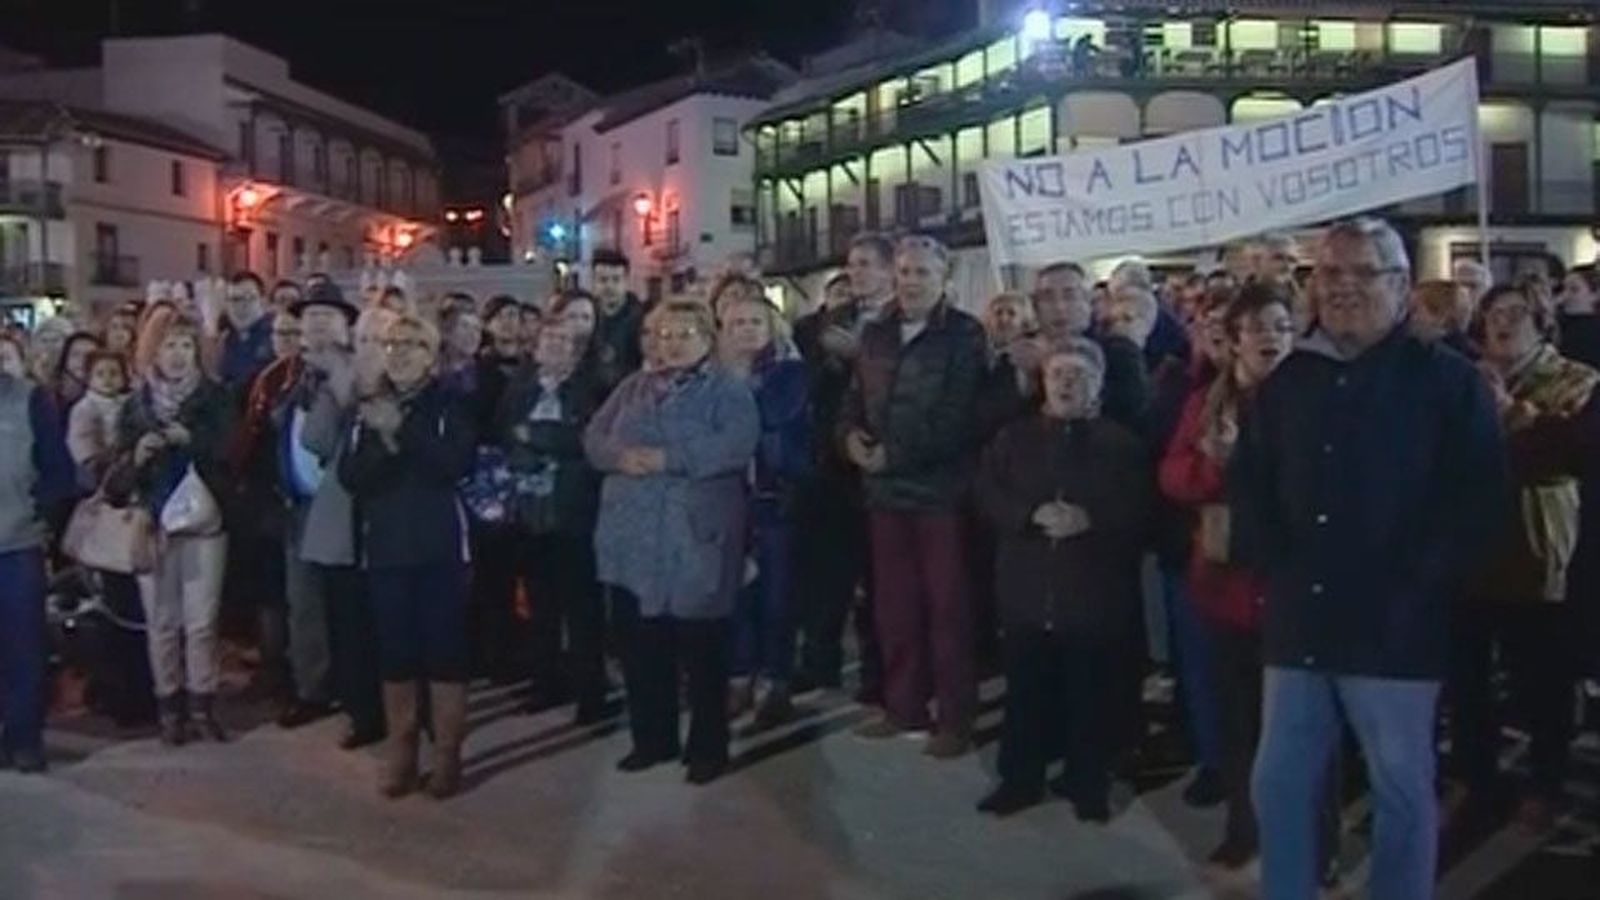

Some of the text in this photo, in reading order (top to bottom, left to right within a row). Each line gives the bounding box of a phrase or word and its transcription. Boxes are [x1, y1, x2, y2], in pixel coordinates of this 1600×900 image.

[1004, 162, 1064, 200] NO
[1086, 159, 1112, 193] A
[1133, 145, 1200, 185] LA
[1005, 124, 1469, 248] ESTAMOS CON VOSOTROS
